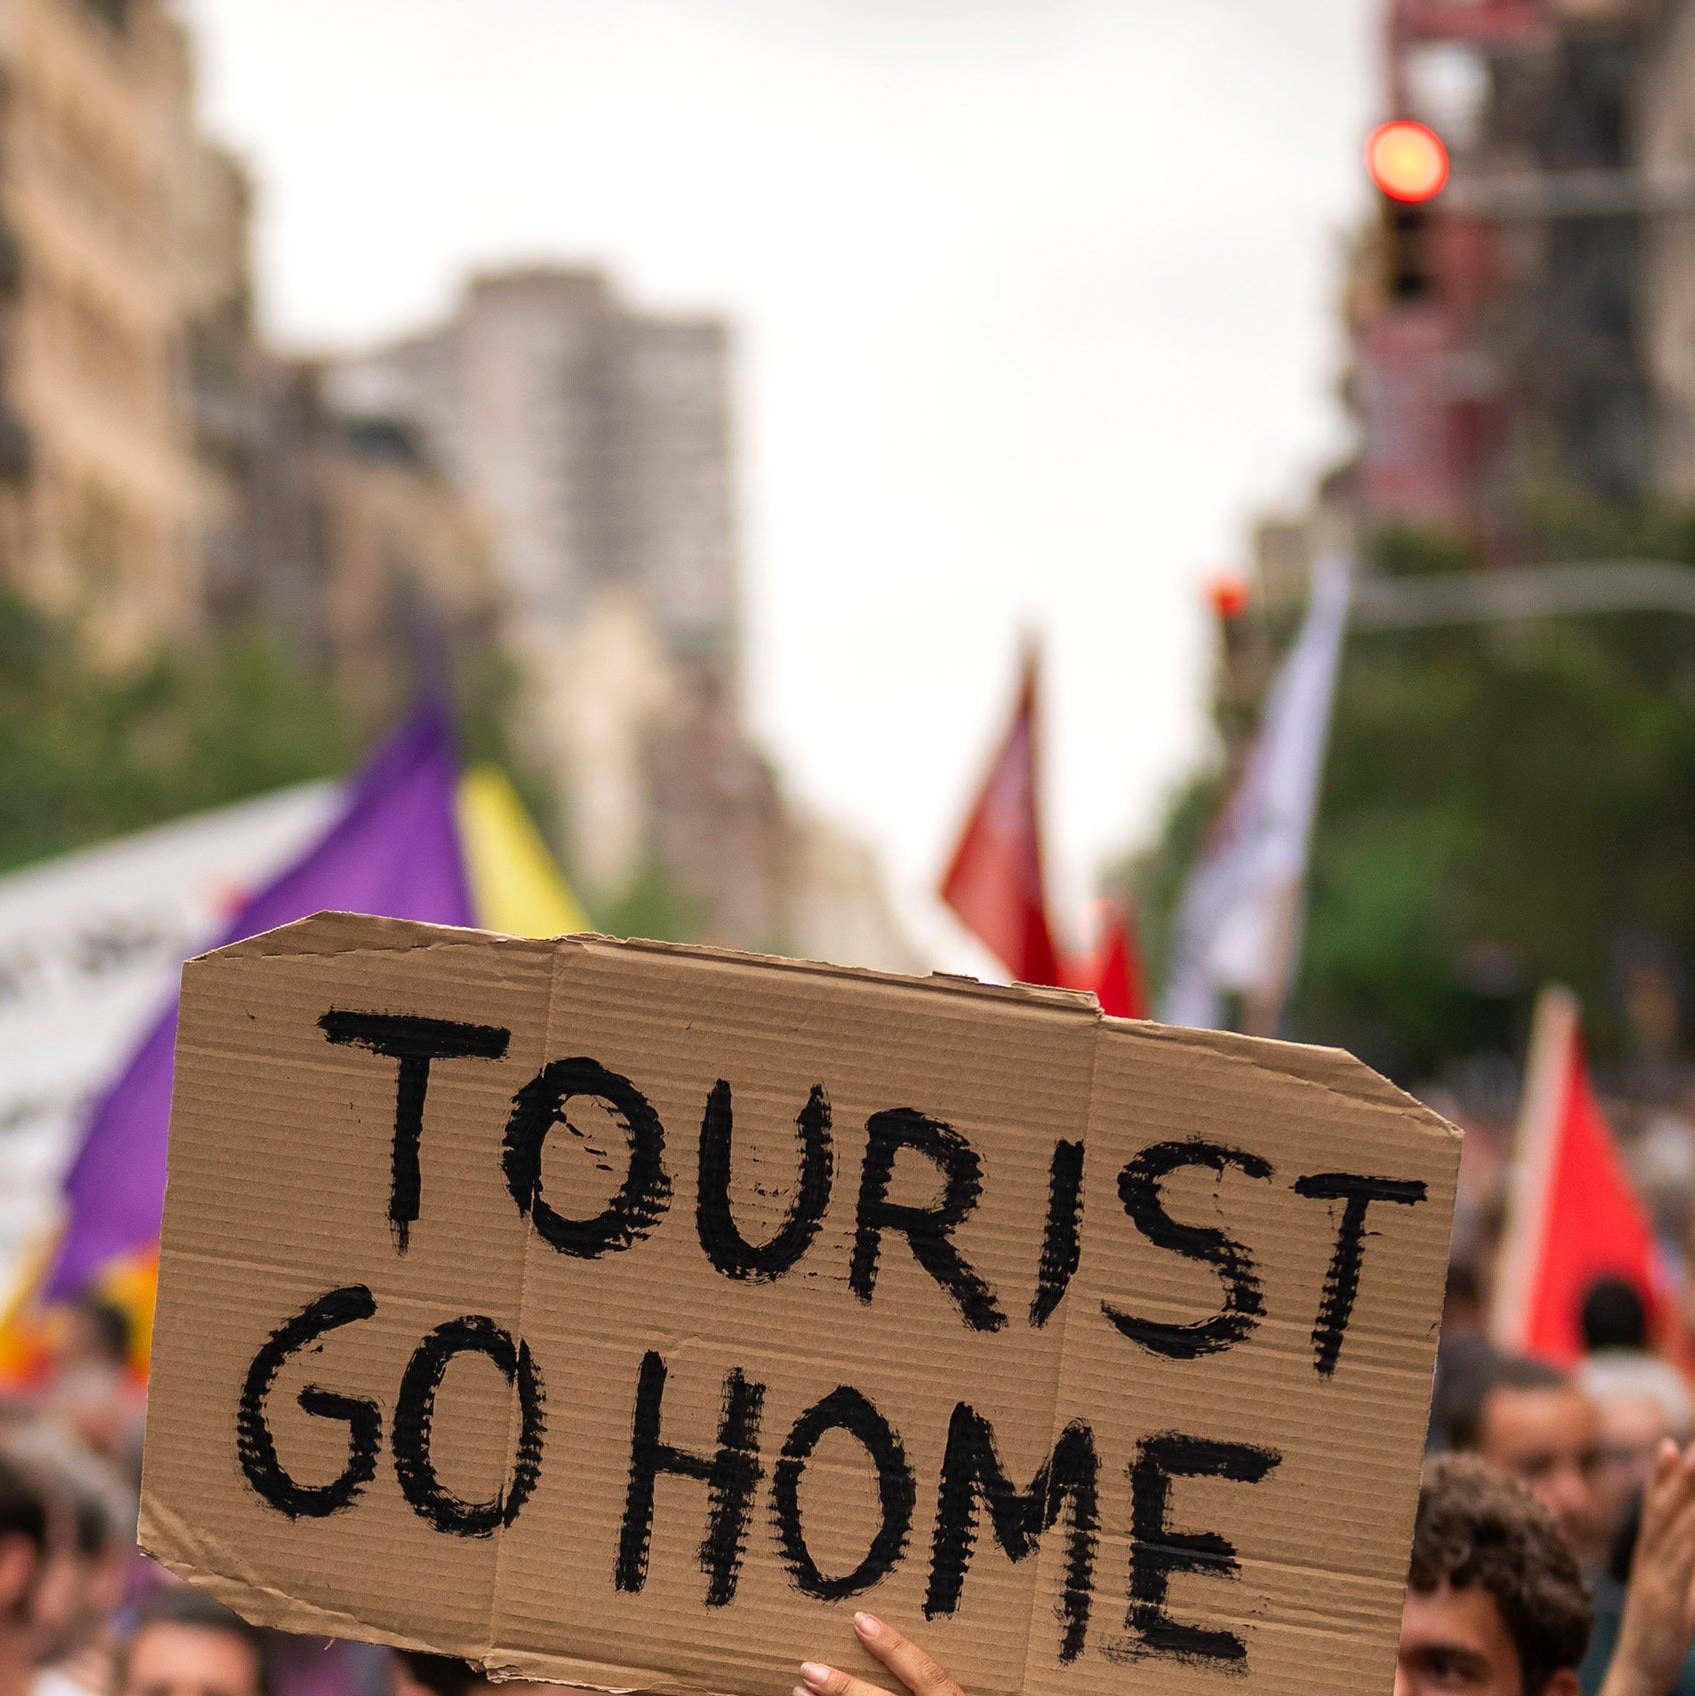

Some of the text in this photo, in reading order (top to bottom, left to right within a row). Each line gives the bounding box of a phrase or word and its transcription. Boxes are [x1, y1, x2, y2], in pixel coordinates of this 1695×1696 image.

[317, 1008, 1429, 1379] TOURIST
[236, 1282, 1283, 1676] GO HOME
